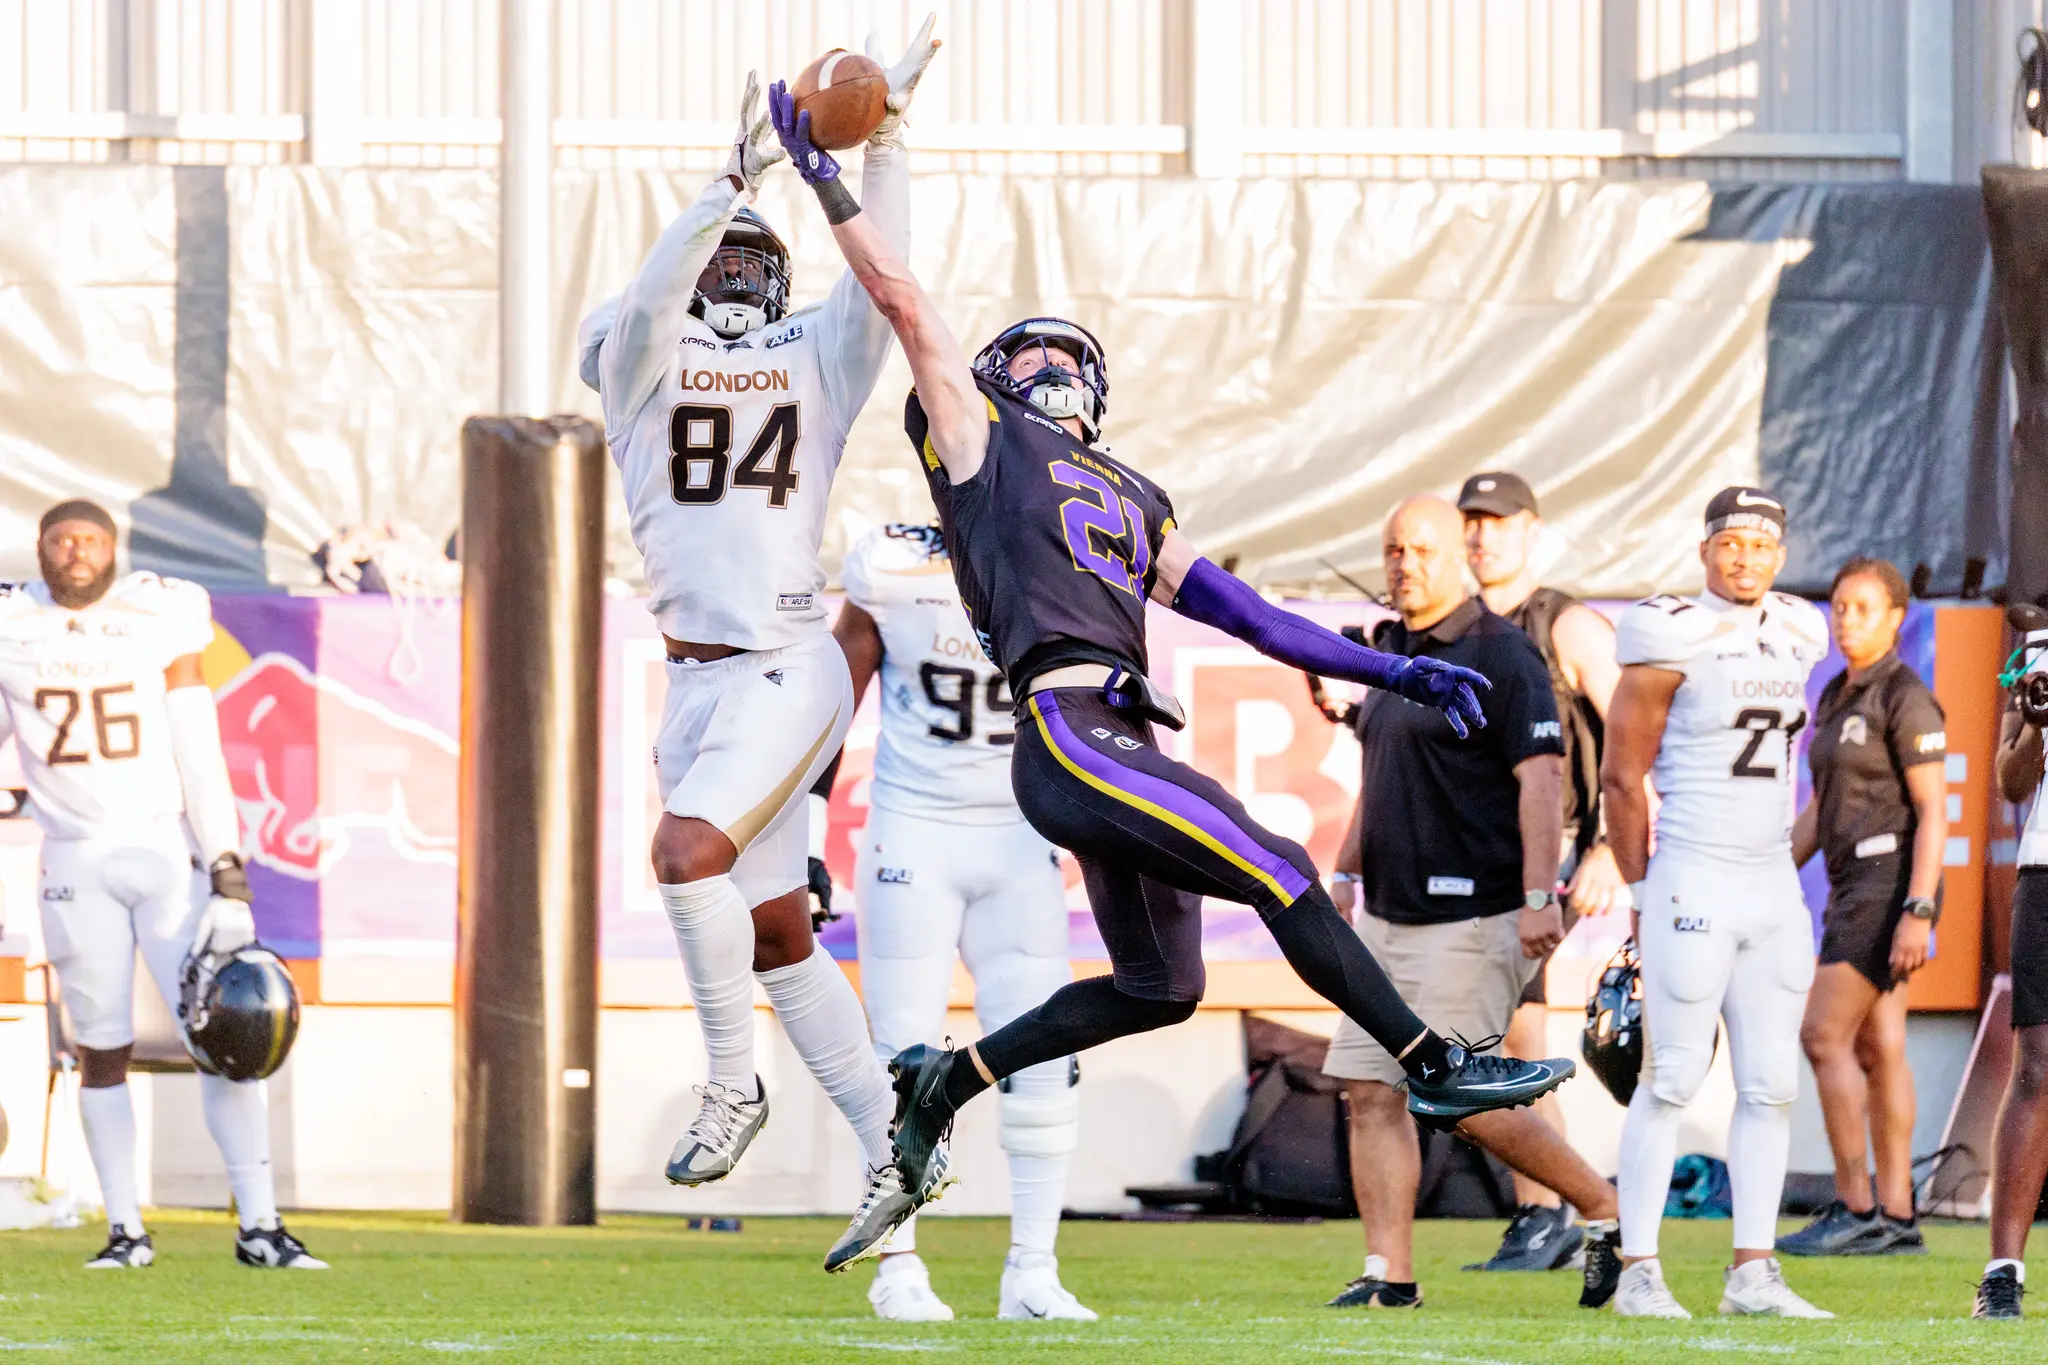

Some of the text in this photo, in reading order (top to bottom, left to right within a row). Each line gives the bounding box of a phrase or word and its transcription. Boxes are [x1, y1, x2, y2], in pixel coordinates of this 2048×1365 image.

[770, 324, 803, 347] AFLE
[681, 369, 790, 392] LONDON
[668, 401, 801, 509] 84
[1069, 449, 1123, 487] VIENNA
[34, 681, 141, 768] 26
